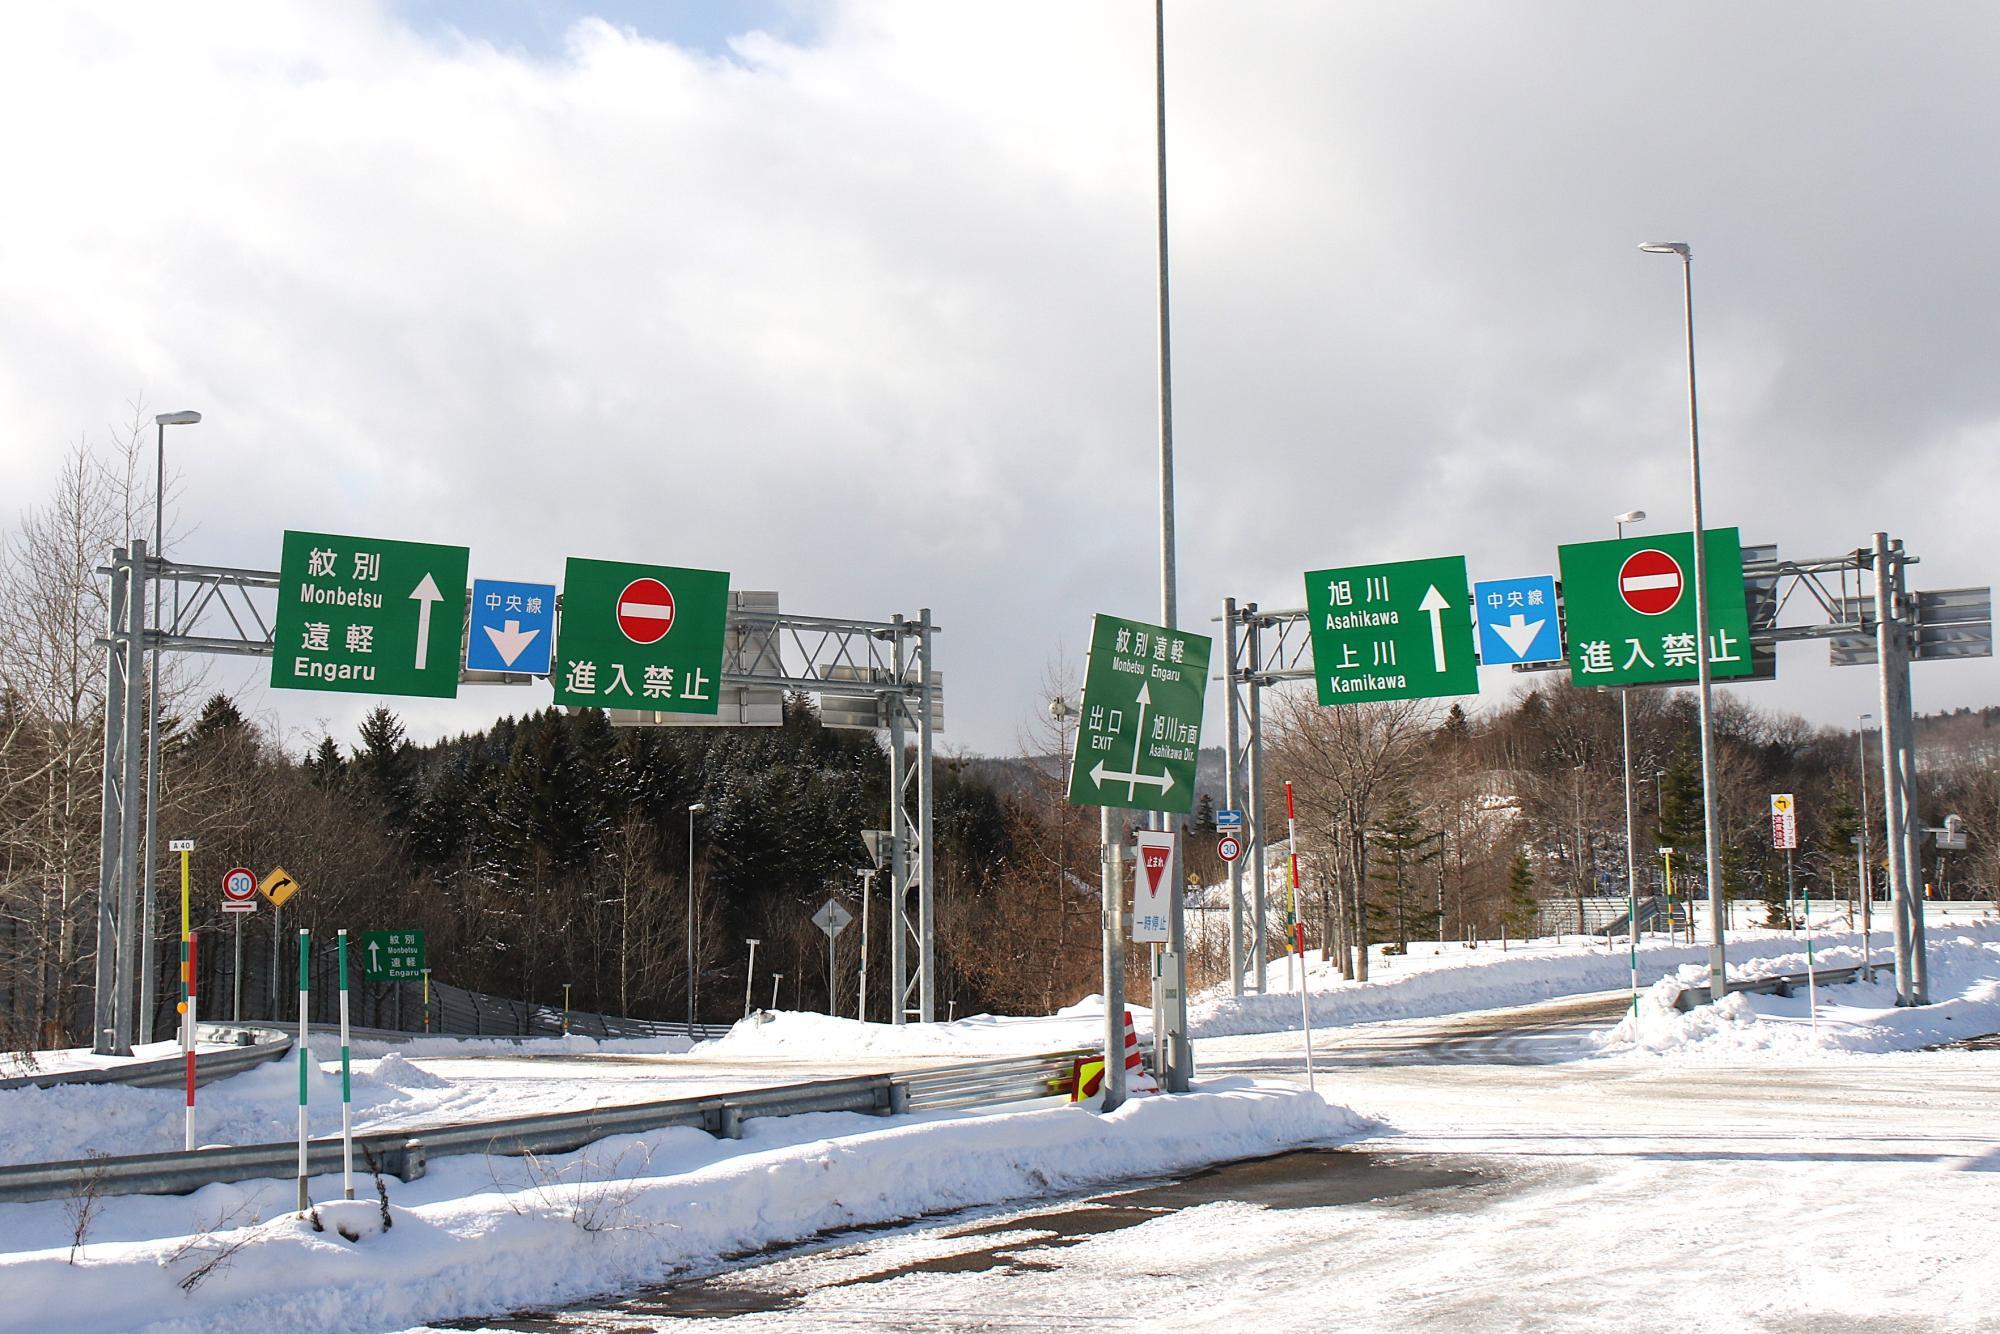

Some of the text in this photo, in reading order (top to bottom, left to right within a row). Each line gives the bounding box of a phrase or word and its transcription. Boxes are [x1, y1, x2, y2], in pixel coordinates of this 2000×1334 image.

[308, 547, 381, 582] 紋別
[300, 583, 382, 609] Monbetsu
[485, 592, 543, 615] 中央線
[1327, 575, 1390, 608] 旭川
[1487, 589, 1545, 610] 中央線
[1325, 609, 1399, 631] Asahikawa
[301, 621, 375, 654] 遠軽
[1335, 639, 1397, 669] 上川
[1580, 628, 1741, 675] 進入禁止
[294, 657, 376, 682] Engaru
[565, 660, 711, 701] 進入禁止
[1112, 656, 1181, 682] Monbetsu Engaru
[1330, 671, 1406, 694] Kamikawa
[1088, 704, 1123, 735] 出口
[1151, 713, 1198, 745] 旭川方面
[1091, 735, 1114, 751] EXIT
[1149, 743, 1195, 762] Asahikawa Dir.
[1146, 855, 1164, 868] 止まれ
[1223, 844, 1236, 855] 30
[231, 877, 250, 892] 30
[389, 969, 419, 978] Engaru
